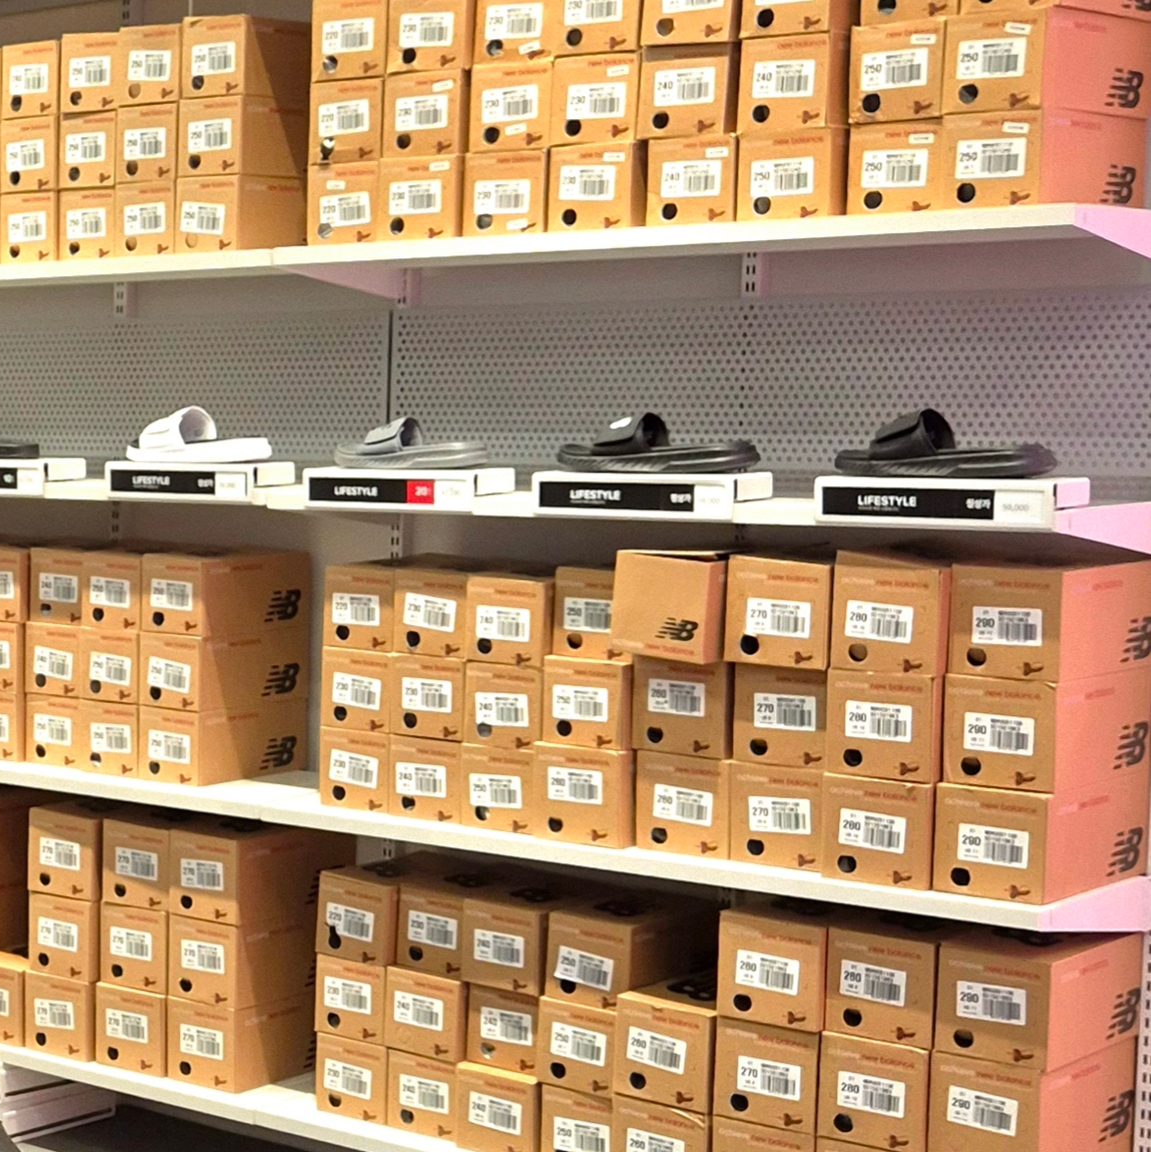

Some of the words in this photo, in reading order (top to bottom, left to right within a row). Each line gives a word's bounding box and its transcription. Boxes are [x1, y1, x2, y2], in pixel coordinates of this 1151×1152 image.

[960, 52, 979, 63] 250
[864, 63, 882, 75] 250
[755, 72, 773, 82] 240
[959, 151, 978, 162] 250
[864, 162, 883, 172] 250
[753, 171, 770, 181] 250
[132, 475, 170, 486] LIFESTYLE
[334, 486, 378, 497] LIFESTYLE
[569, 489, 622, 501] LIFESTYLE
[857, 495, 917, 508] LIFESTYLE
[750, 609, 768, 619] 270
[756, 702, 775, 714] 270
[752, 806, 769, 817] 270
[42, 845, 54, 855] 270
[117, 854, 130, 864] 270
[182, 866, 195, 876] 270
[40, 925, 52, 935] 270
[410, 919, 424, 930] 230
[112, 935, 124, 945] 270
[476, 938, 491, 949] 240
[184, 948, 196, 958] 270
[560, 955, 576, 967] 250
[327, 985, 340, 996] 230
[37, 1006, 48, 1015] 270
[397, 1000, 410, 1011] 240
[108, 1017, 120, 1027] 270
[483, 1016, 498, 1026] 240
[182, 1032, 195, 1043] 270
[554, 1032, 569, 1044] 250
[327, 1067, 340, 1078] 230
[741, 1066, 758, 1078] 270
[402, 1083, 416, 1094] 240
[472, 1101, 487, 1113] 240
[557, 1126, 572, 1138] 250
